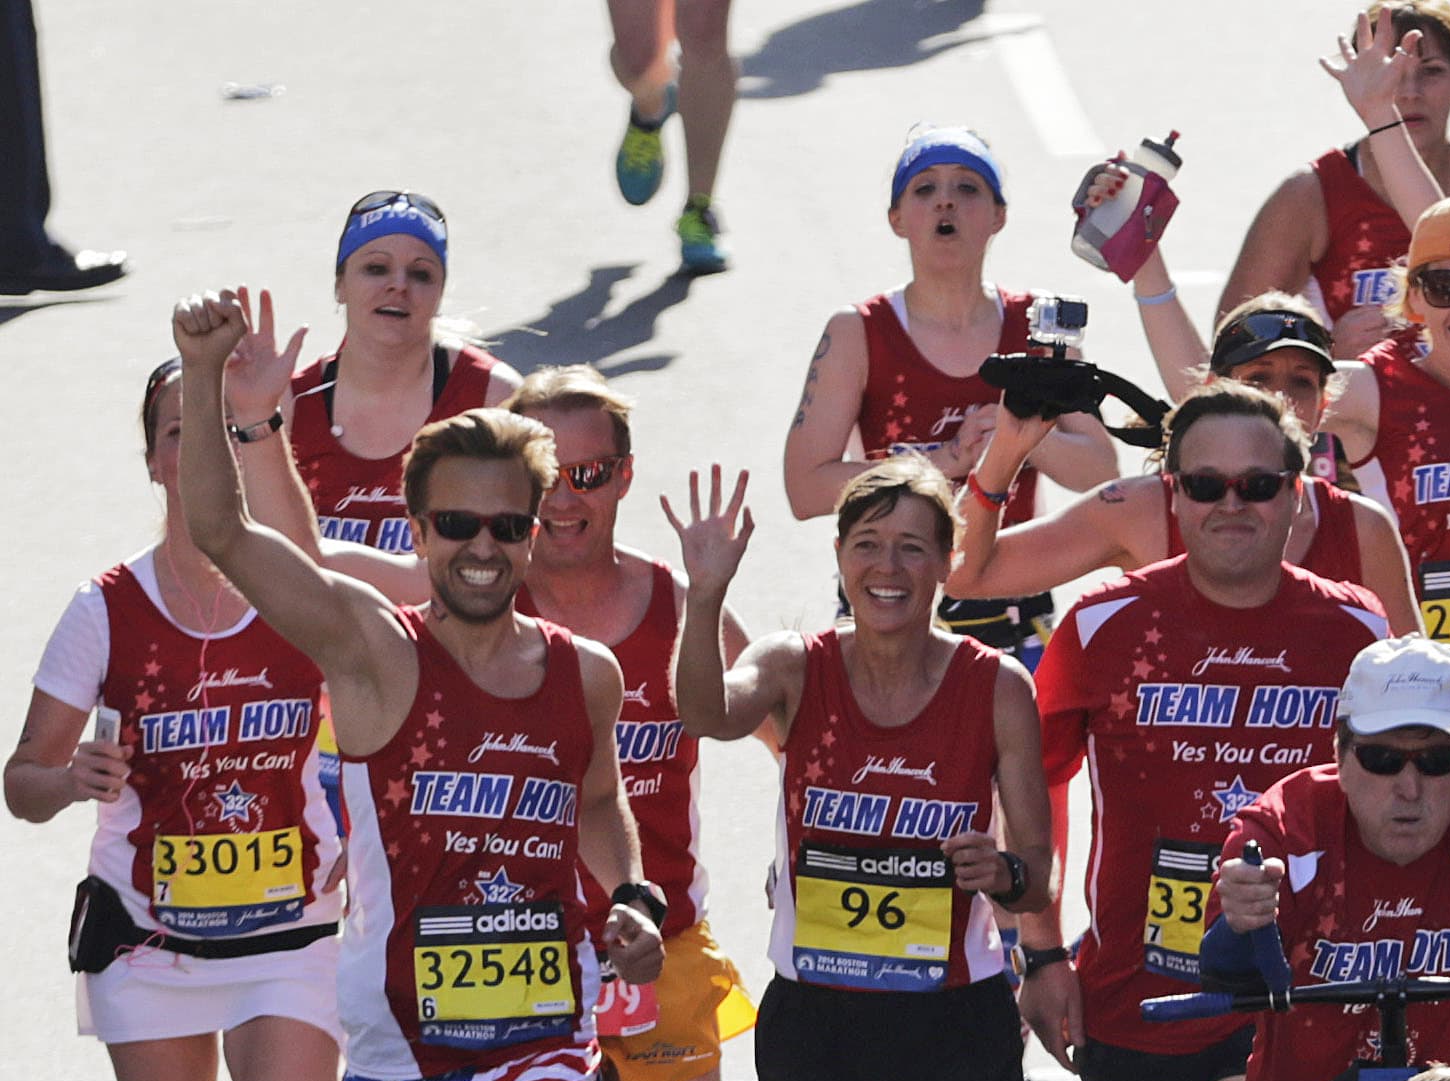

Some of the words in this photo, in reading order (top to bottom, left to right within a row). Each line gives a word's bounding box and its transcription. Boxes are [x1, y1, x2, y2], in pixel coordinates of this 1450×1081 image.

[1191, 646, 1233, 678] John
[1230, 646, 1293, 674] Hancock
[1135, 682, 1240, 728] TEAM
[1245, 683, 1342, 730] HOYT
[140, 705, 232, 754] TEAM
[239, 698, 313, 741] HOYT
[615, 721, 686, 763] HOYT
[179, 757, 211, 781] Yes
[214, 755, 250, 777] You
[252, 748, 297, 772] Can!
[467, 730, 508, 764] John
[506, 733, 560, 766] Hancock
[1171, 739, 1207, 763] Yes
[1213, 740, 1255, 765] You
[1258, 742, 1314, 765] Can!
[623, 772, 663, 799] Can!
[851, 754, 889, 786] John
[885, 755, 937, 786] Hancock
[409, 770, 510, 820] TEAM
[802, 786, 891, 837] TEAM
[891, 797, 979, 842] HOYT
[156, 830, 295, 877] 33015
[443, 830, 479, 853] Yes
[481, 832, 520, 857] You
[523, 835, 564, 861] Can!
[860, 855, 947, 879] adidas
[156, 880, 170, 903] 7
[475, 908, 560, 934] adidas
[840, 886, 907, 931] 96
[1148, 922, 1161, 943] 7
[420, 944, 563, 992] 32548
[1309, 938, 1407, 983] TEAM
[421, 996, 436, 1019] 6
